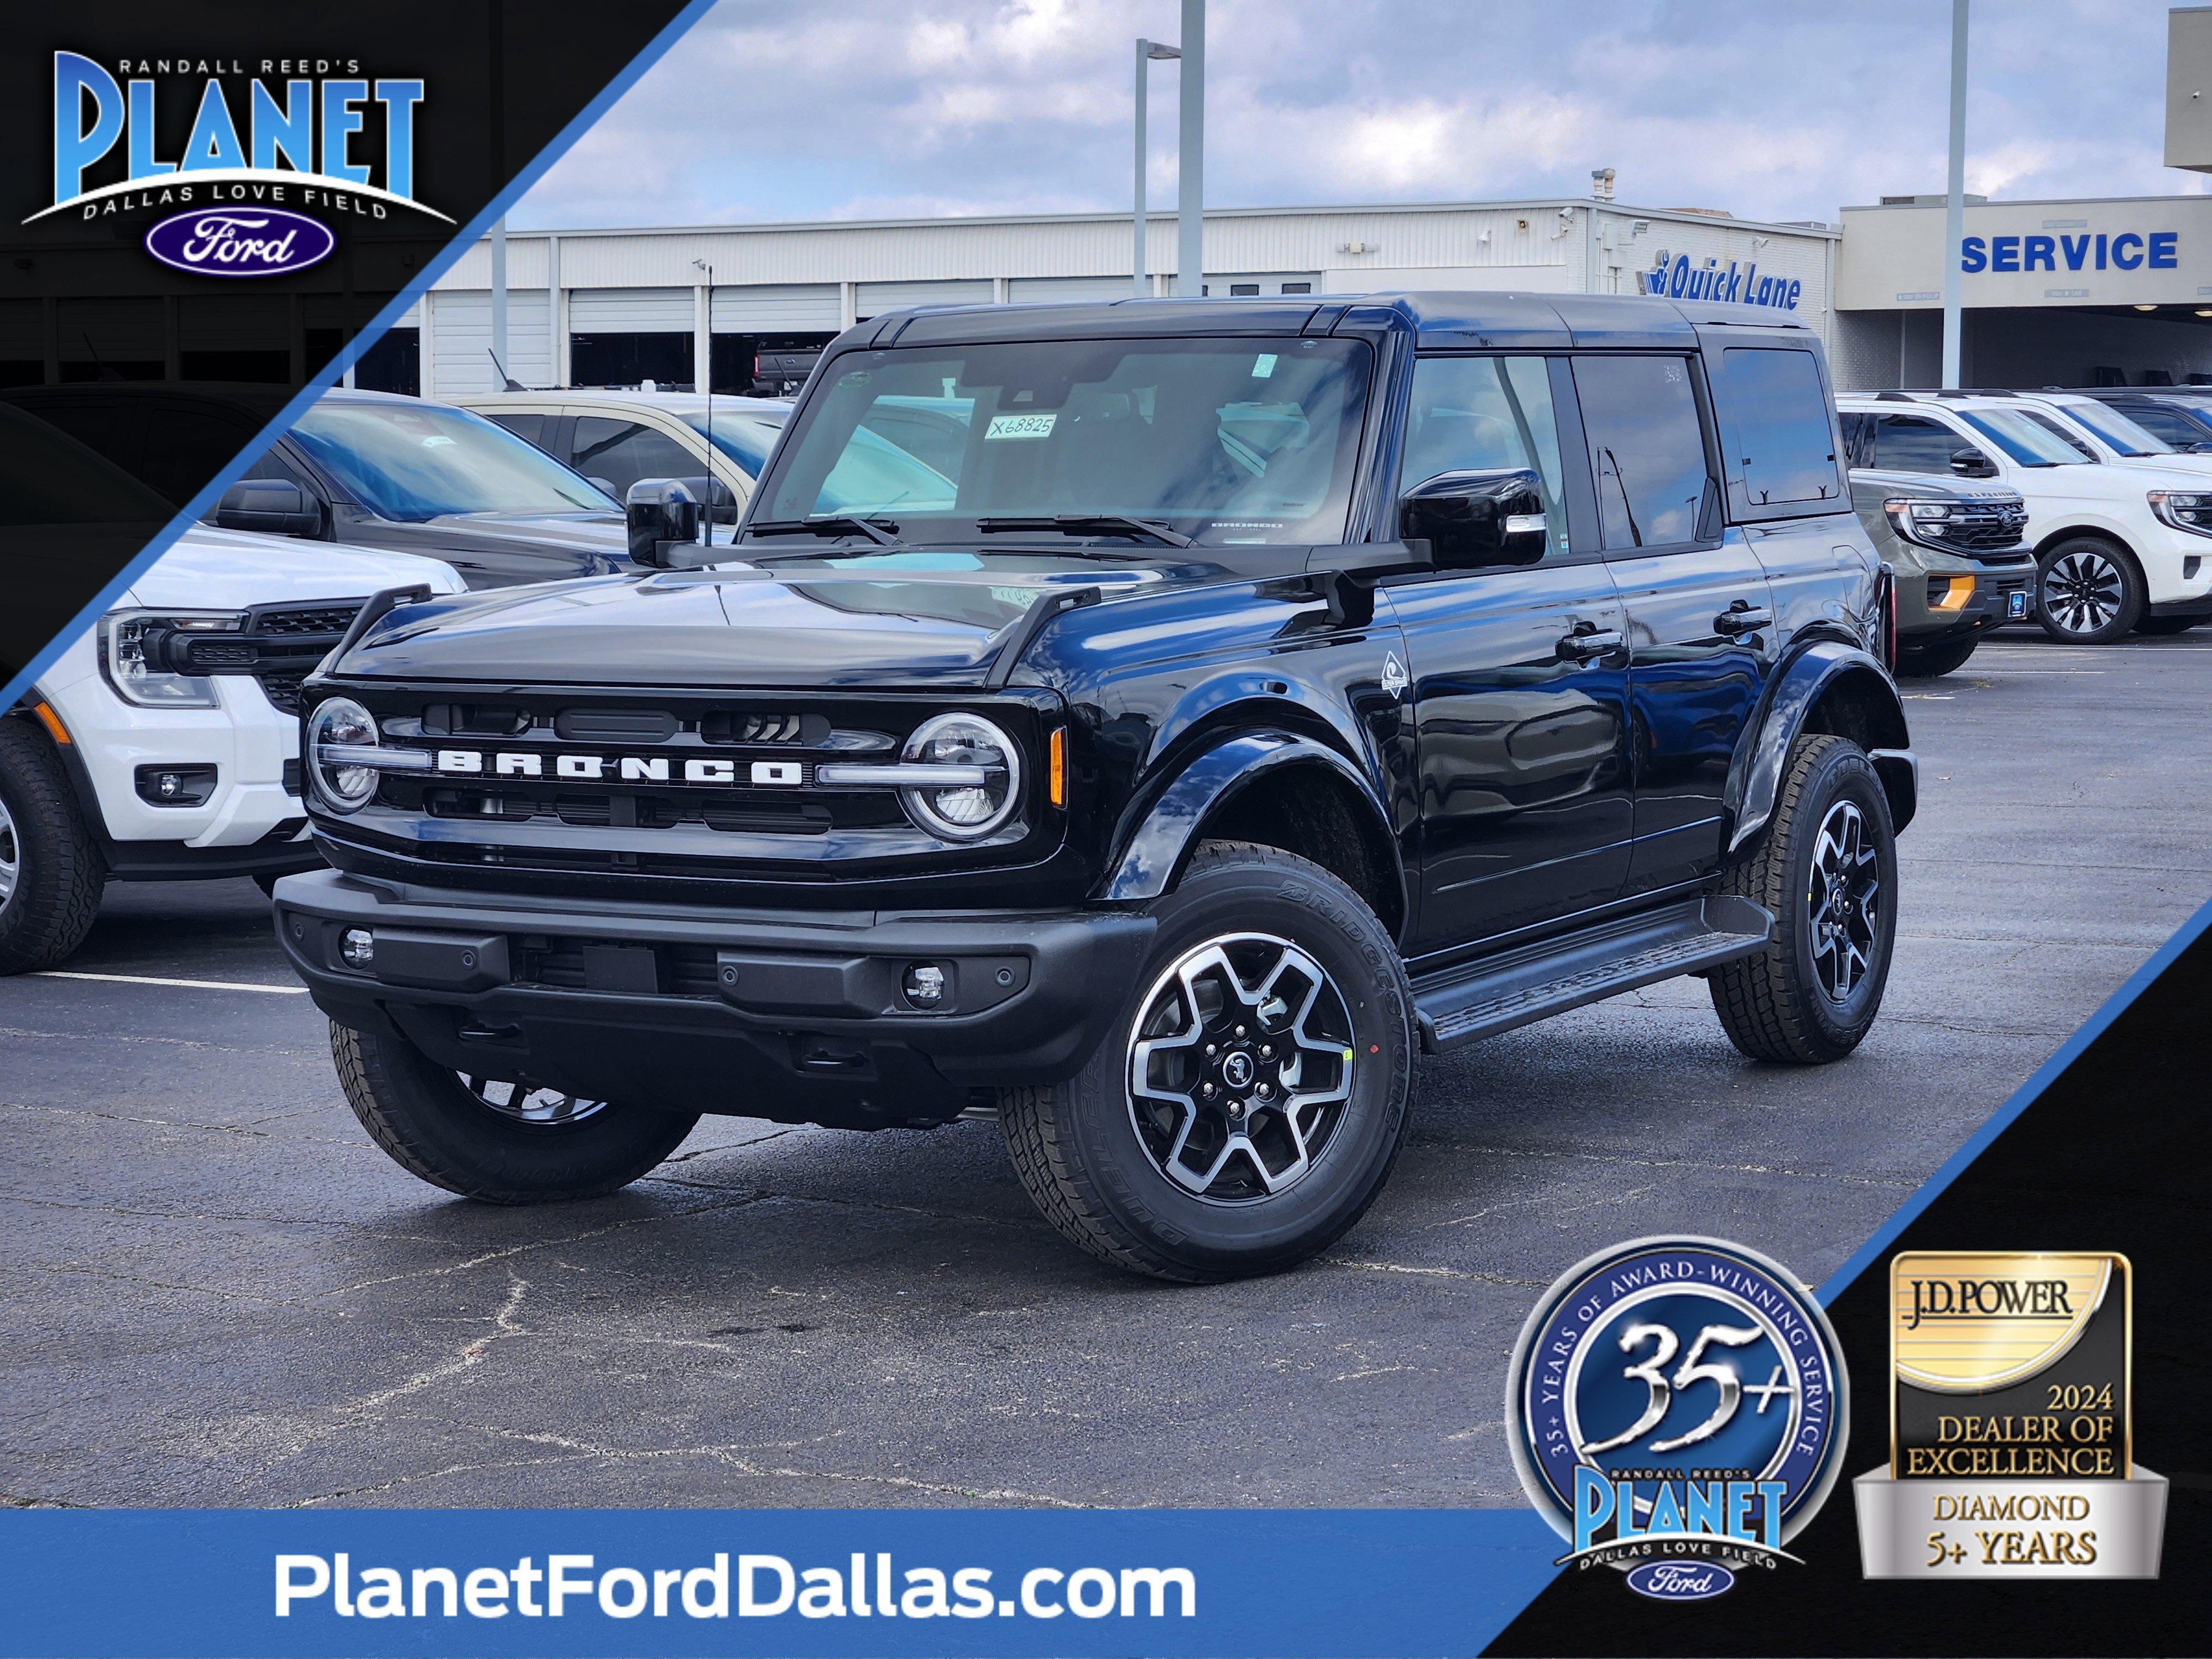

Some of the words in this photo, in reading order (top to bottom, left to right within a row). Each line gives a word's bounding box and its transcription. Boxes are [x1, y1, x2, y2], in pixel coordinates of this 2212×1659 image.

[1961, 232, 2178, 273] SERVICE
[1670, 254, 1742, 302] Quick
[1744, 263, 1801, 311] Lane
[990, 418, 1054, 436] X68825
[438, 750, 802, 785] BRONCO
[1277, 880, 1408, 1134] BRIDGESTONE
